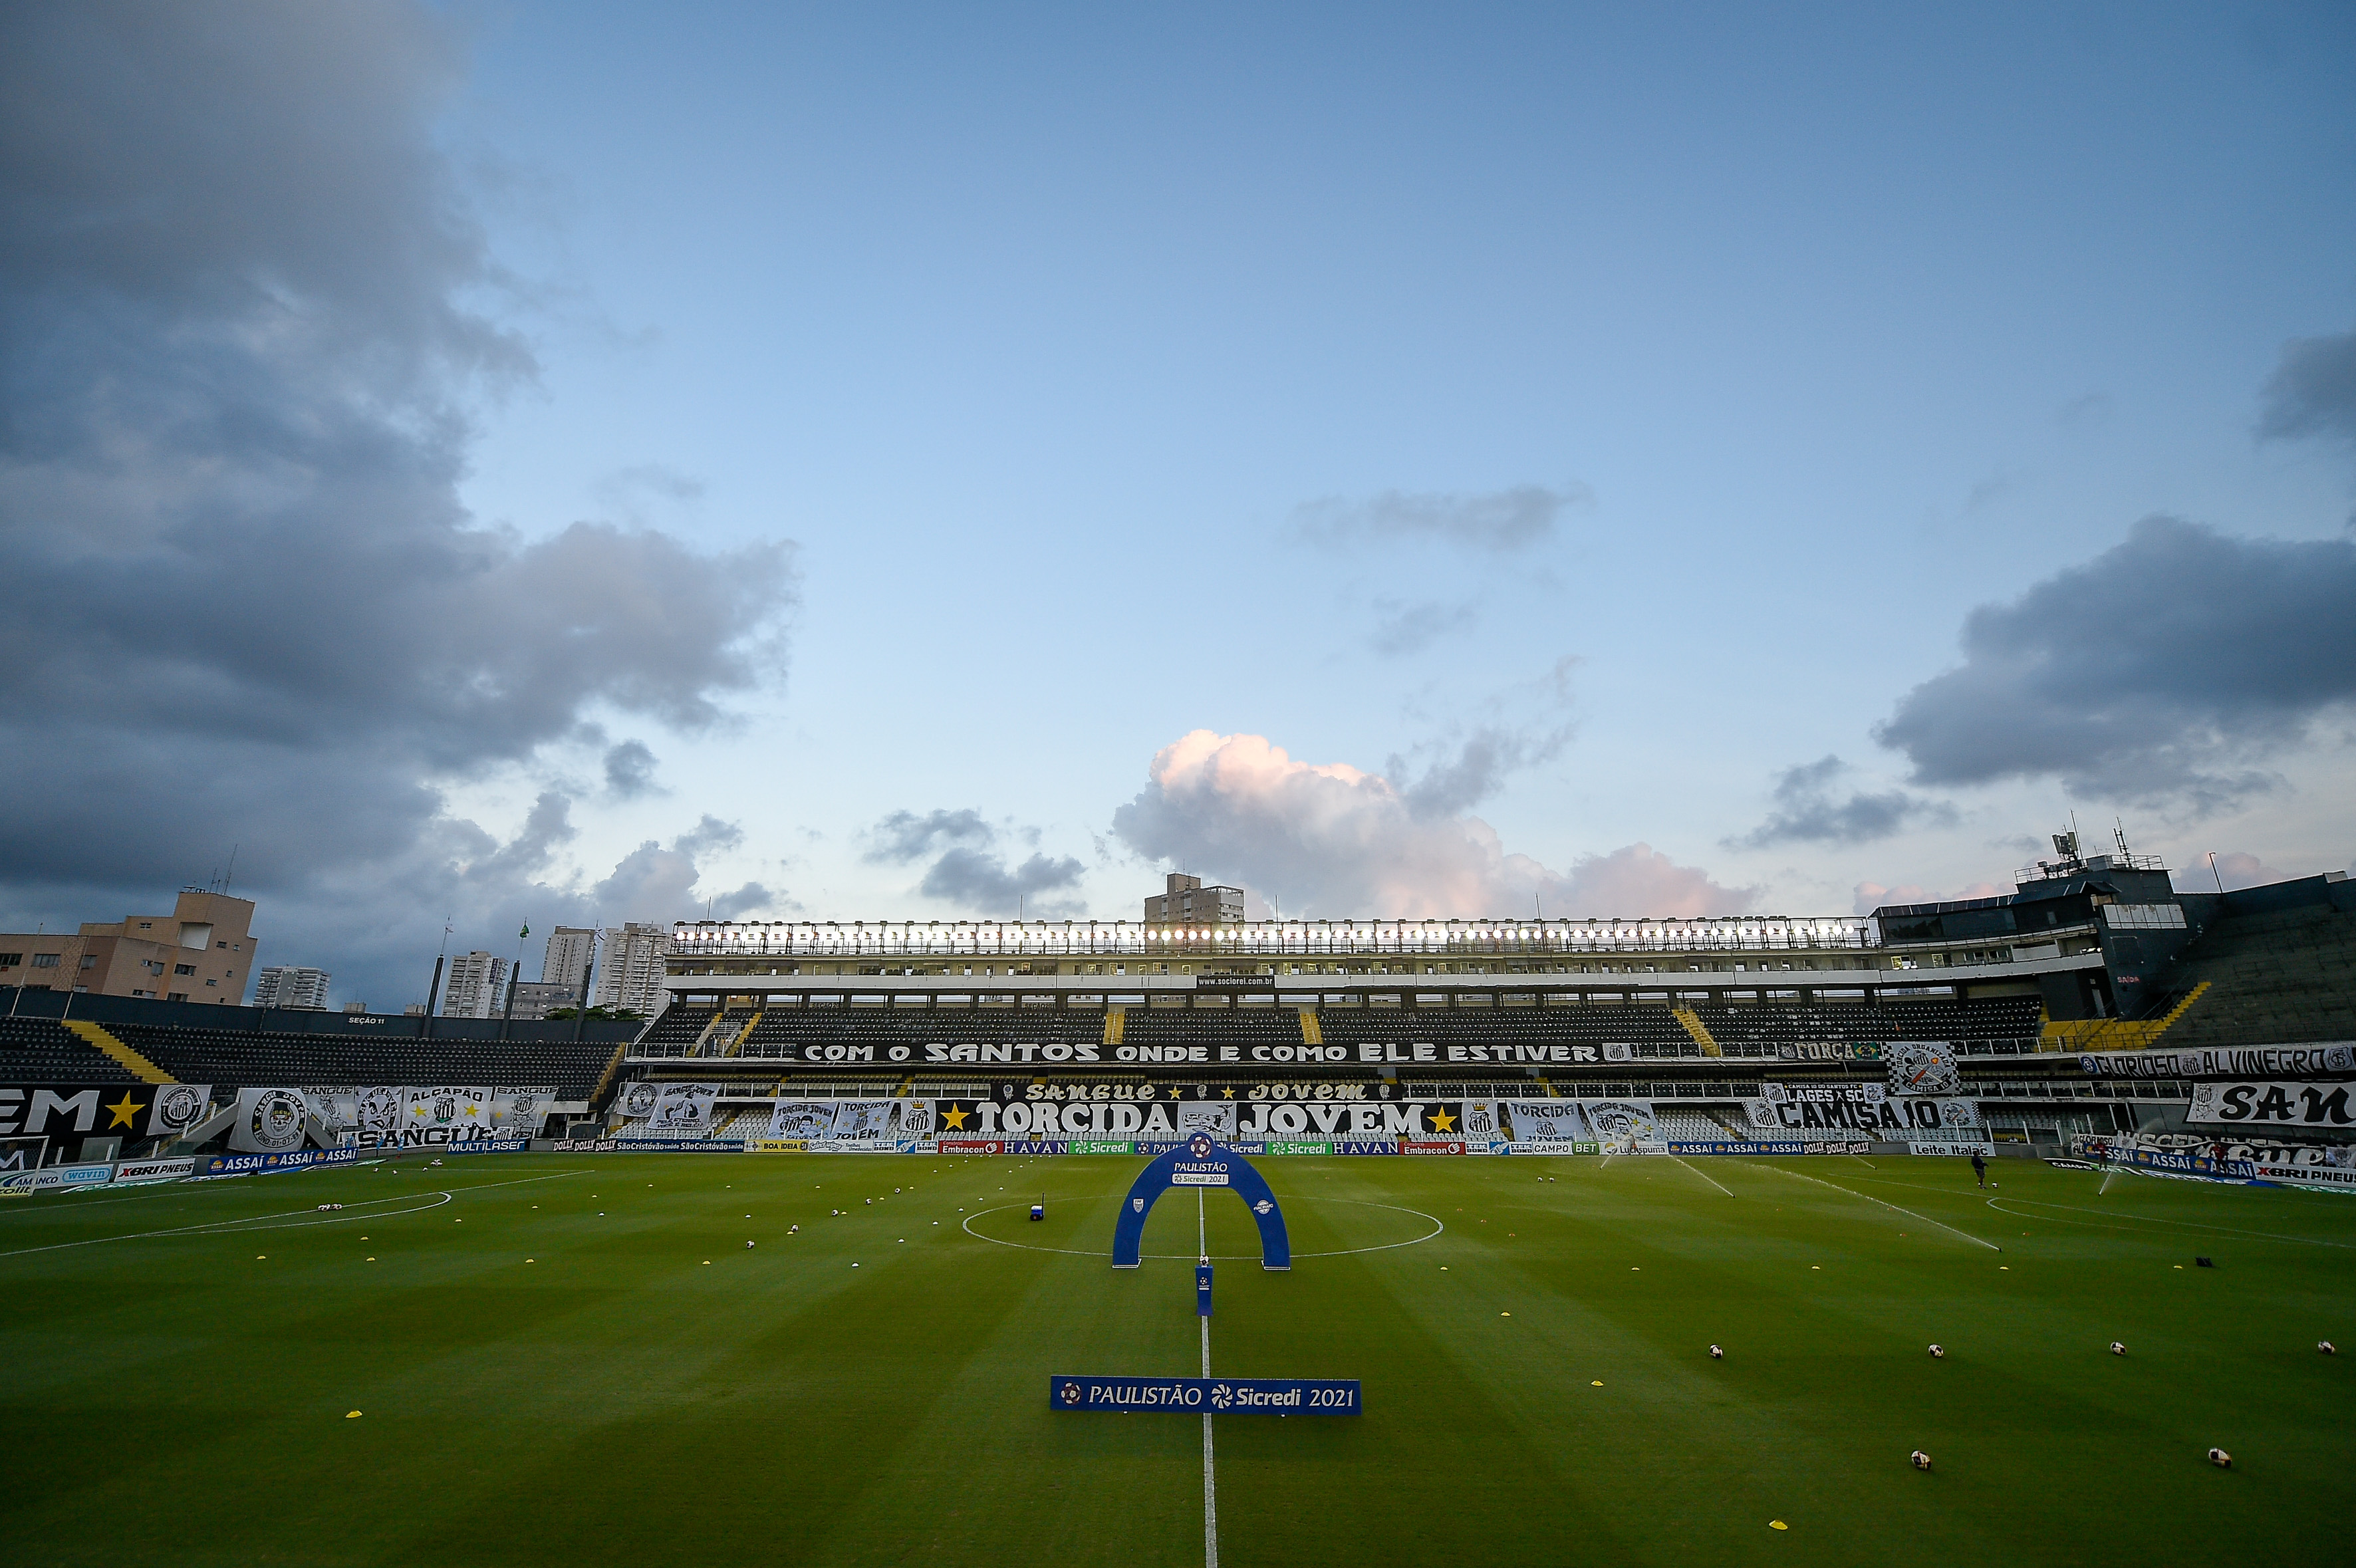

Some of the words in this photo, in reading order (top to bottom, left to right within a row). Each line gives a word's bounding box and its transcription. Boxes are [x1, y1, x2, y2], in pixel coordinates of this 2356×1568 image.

[805, 1045, 874, 1061] COM
[888, 1046, 910, 1061] O
[924, 1043, 1100, 1062] SANTOS
[1116, 1046, 1208, 1062] ONDE
[1220, 1046, 1240, 1062] E
[1252, 1046, 1347, 1062] COMO
[1359, 1043, 1437, 1062] ELE
[1448, 1045, 1599, 1063] ESTIVER
[1795, 1043, 1856, 1060] FORÇA
[2095, 1055, 2182, 1076] GLORIOSO
[410, 1087, 483, 1103] ALÇAPÃO
[1785, 1090, 1834, 1102] LAGES
[1846, 1090, 1864, 1102] SC
[845, 1101, 890, 1112] TORCIDA
[1511, 1103, 1575, 1118] TORCIDA
[976, 1103, 1176, 1132] TORCIDA
[1240, 1105, 1426, 1134] JOVEM
[1776, 1102, 1902, 1128] CAMISA
[1900, 1101, 1942, 1128] 10
[553, 1140, 574, 1151] DOLLY
[575, 1140, 595, 1151] DOLLY
[596, 1140, 616, 1151] DOLLY
[1004, 1142, 1068, 1153] HAVAN
[1091, 1142, 1128, 1152] Sicredi
[1230, 1143, 1262, 1153] Sicredi
[1288, 1143, 1326, 1154] Sicredi
[1333, 1142, 1398, 1154] HAVAN
[1534, 1144, 1569, 1153] CAMPO
[1576, 1143, 1596, 1152] BET
[1915, 1144, 1945, 1155] Leite
[1951, 1144, 1988, 1156] Italac
[118, 1165, 161, 1178] XBRI
[160, 1163, 194, 1174] PNEUS
[1174, 1162, 1228, 1172] PAULISTÃO
[2258, 1166, 2308, 1180] XBRI
[68, 1169, 105, 1179] wavin
[1089, 1384, 1202, 1406] PAULISTÃO
[1236, 1388, 1301, 1406] Sicredi
[1309, 1389, 1354, 1407] 2021
